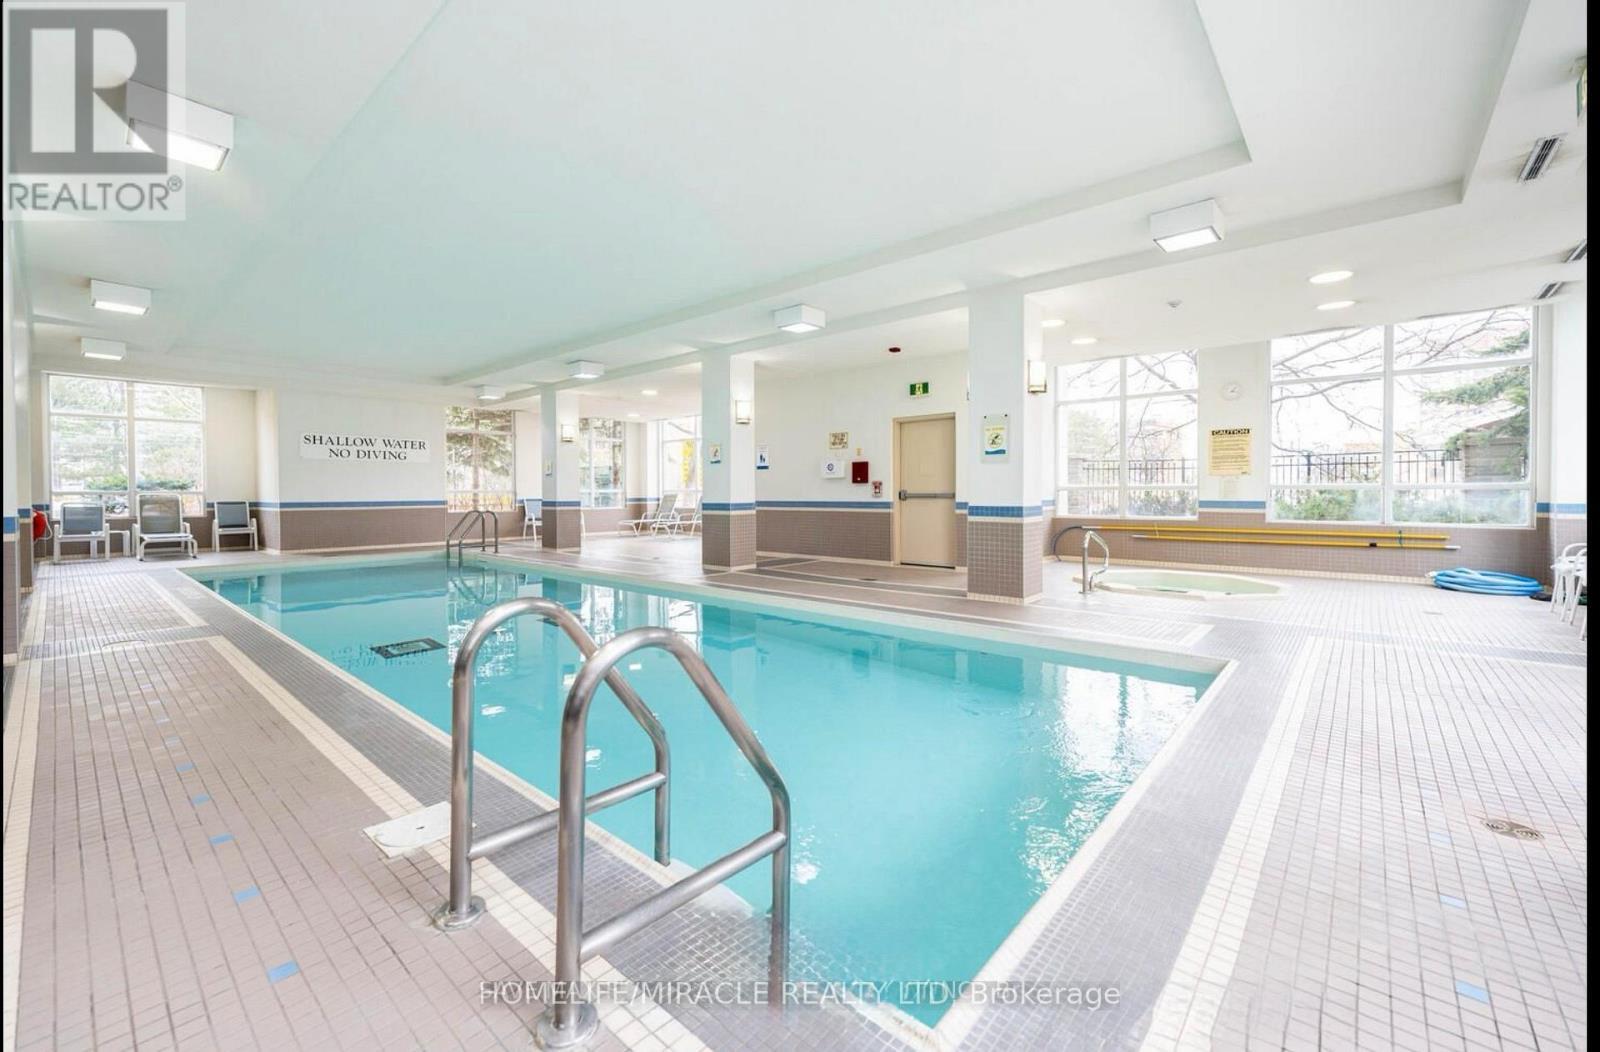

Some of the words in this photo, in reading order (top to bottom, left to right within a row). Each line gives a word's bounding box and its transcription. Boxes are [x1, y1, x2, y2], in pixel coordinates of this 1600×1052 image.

[303, 434, 377, 447] SHALLOW
[382, 438, 427, 450] WATER
[328, 448, 351, 459] NO
[356, 449, 407, 461] DIVING
